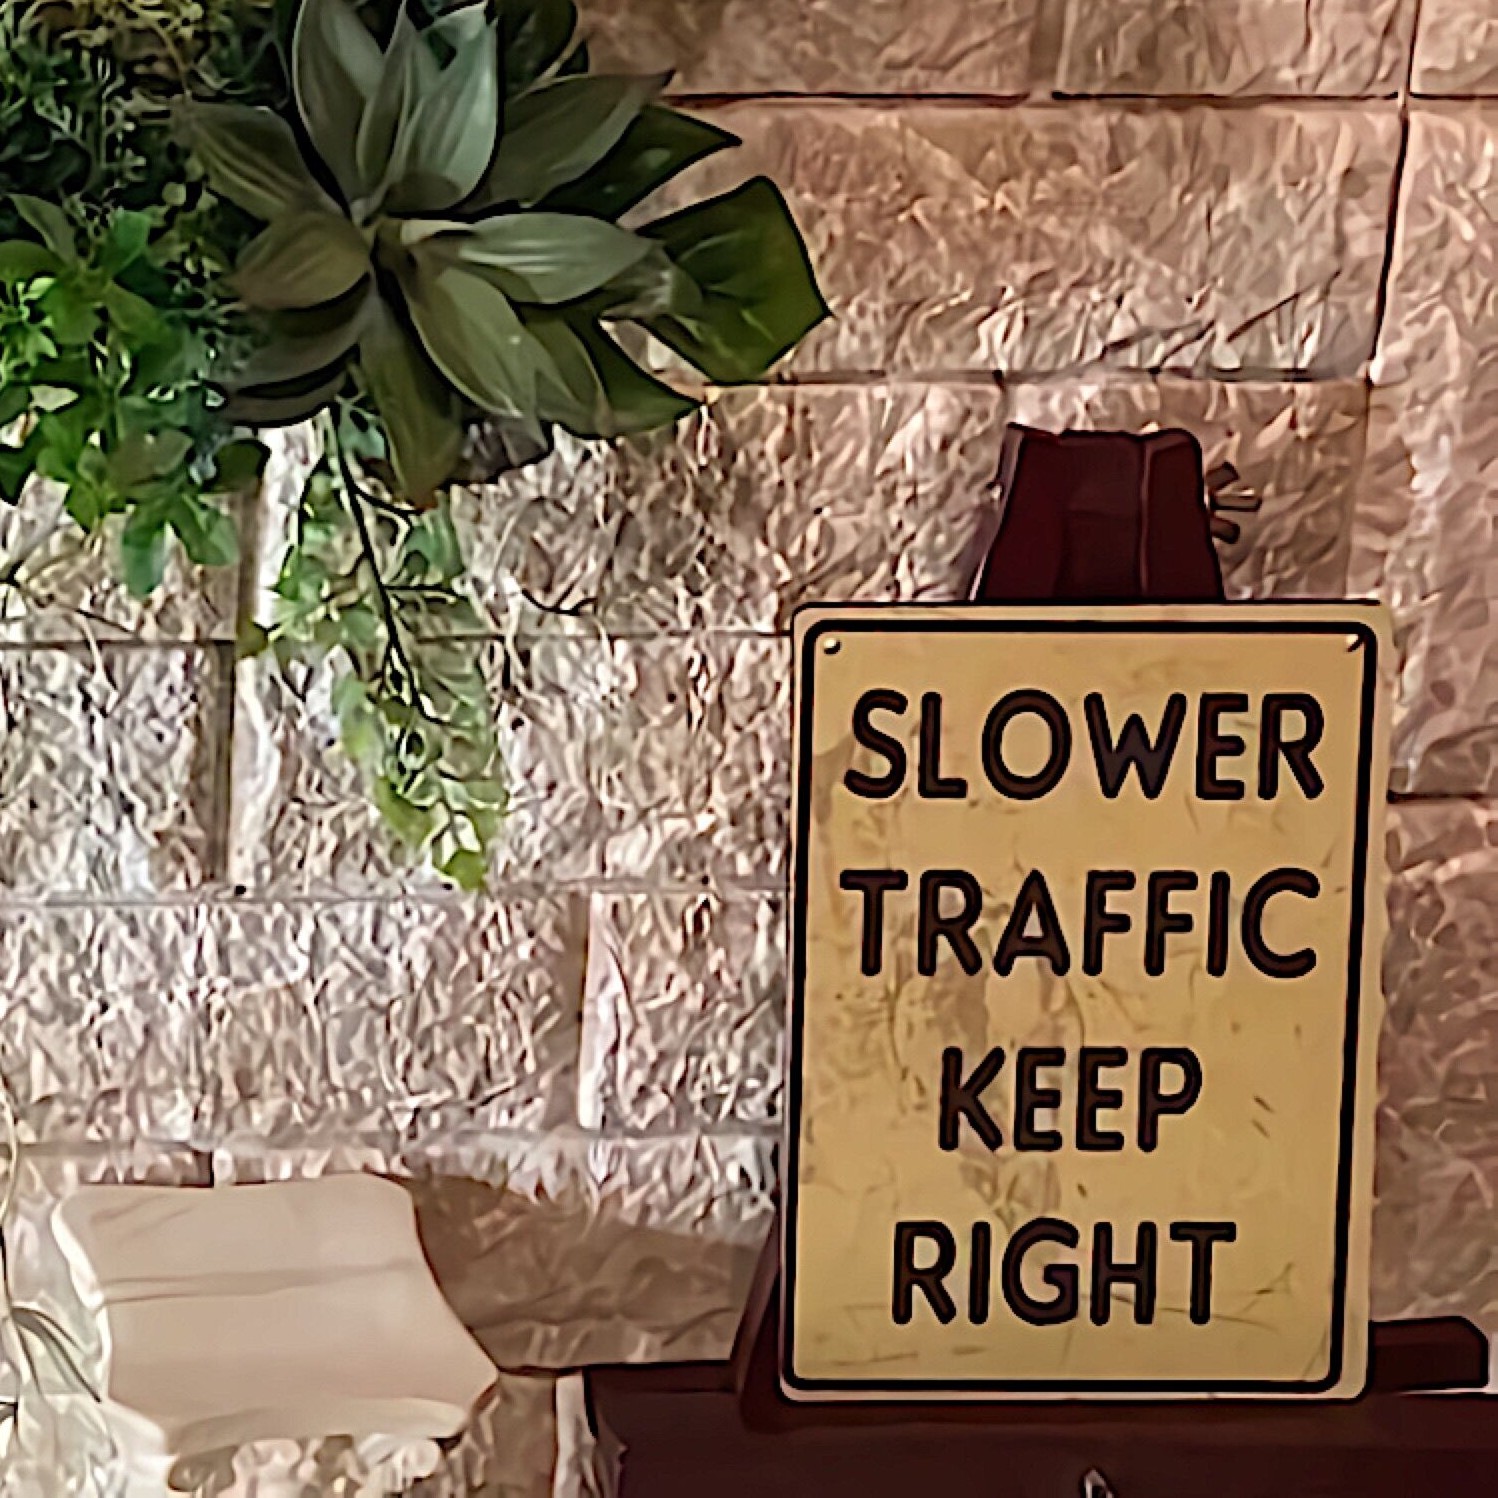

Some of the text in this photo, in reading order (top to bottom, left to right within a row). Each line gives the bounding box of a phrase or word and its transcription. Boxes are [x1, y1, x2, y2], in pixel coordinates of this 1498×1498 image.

[843, 688, 1325, 801] SLOWER
[839, 867, 1321, 979] TRAFFIC
[938, 1045, 1203, 1153] KEEP
[891, 1216, 1237, 1327] RIGHT
